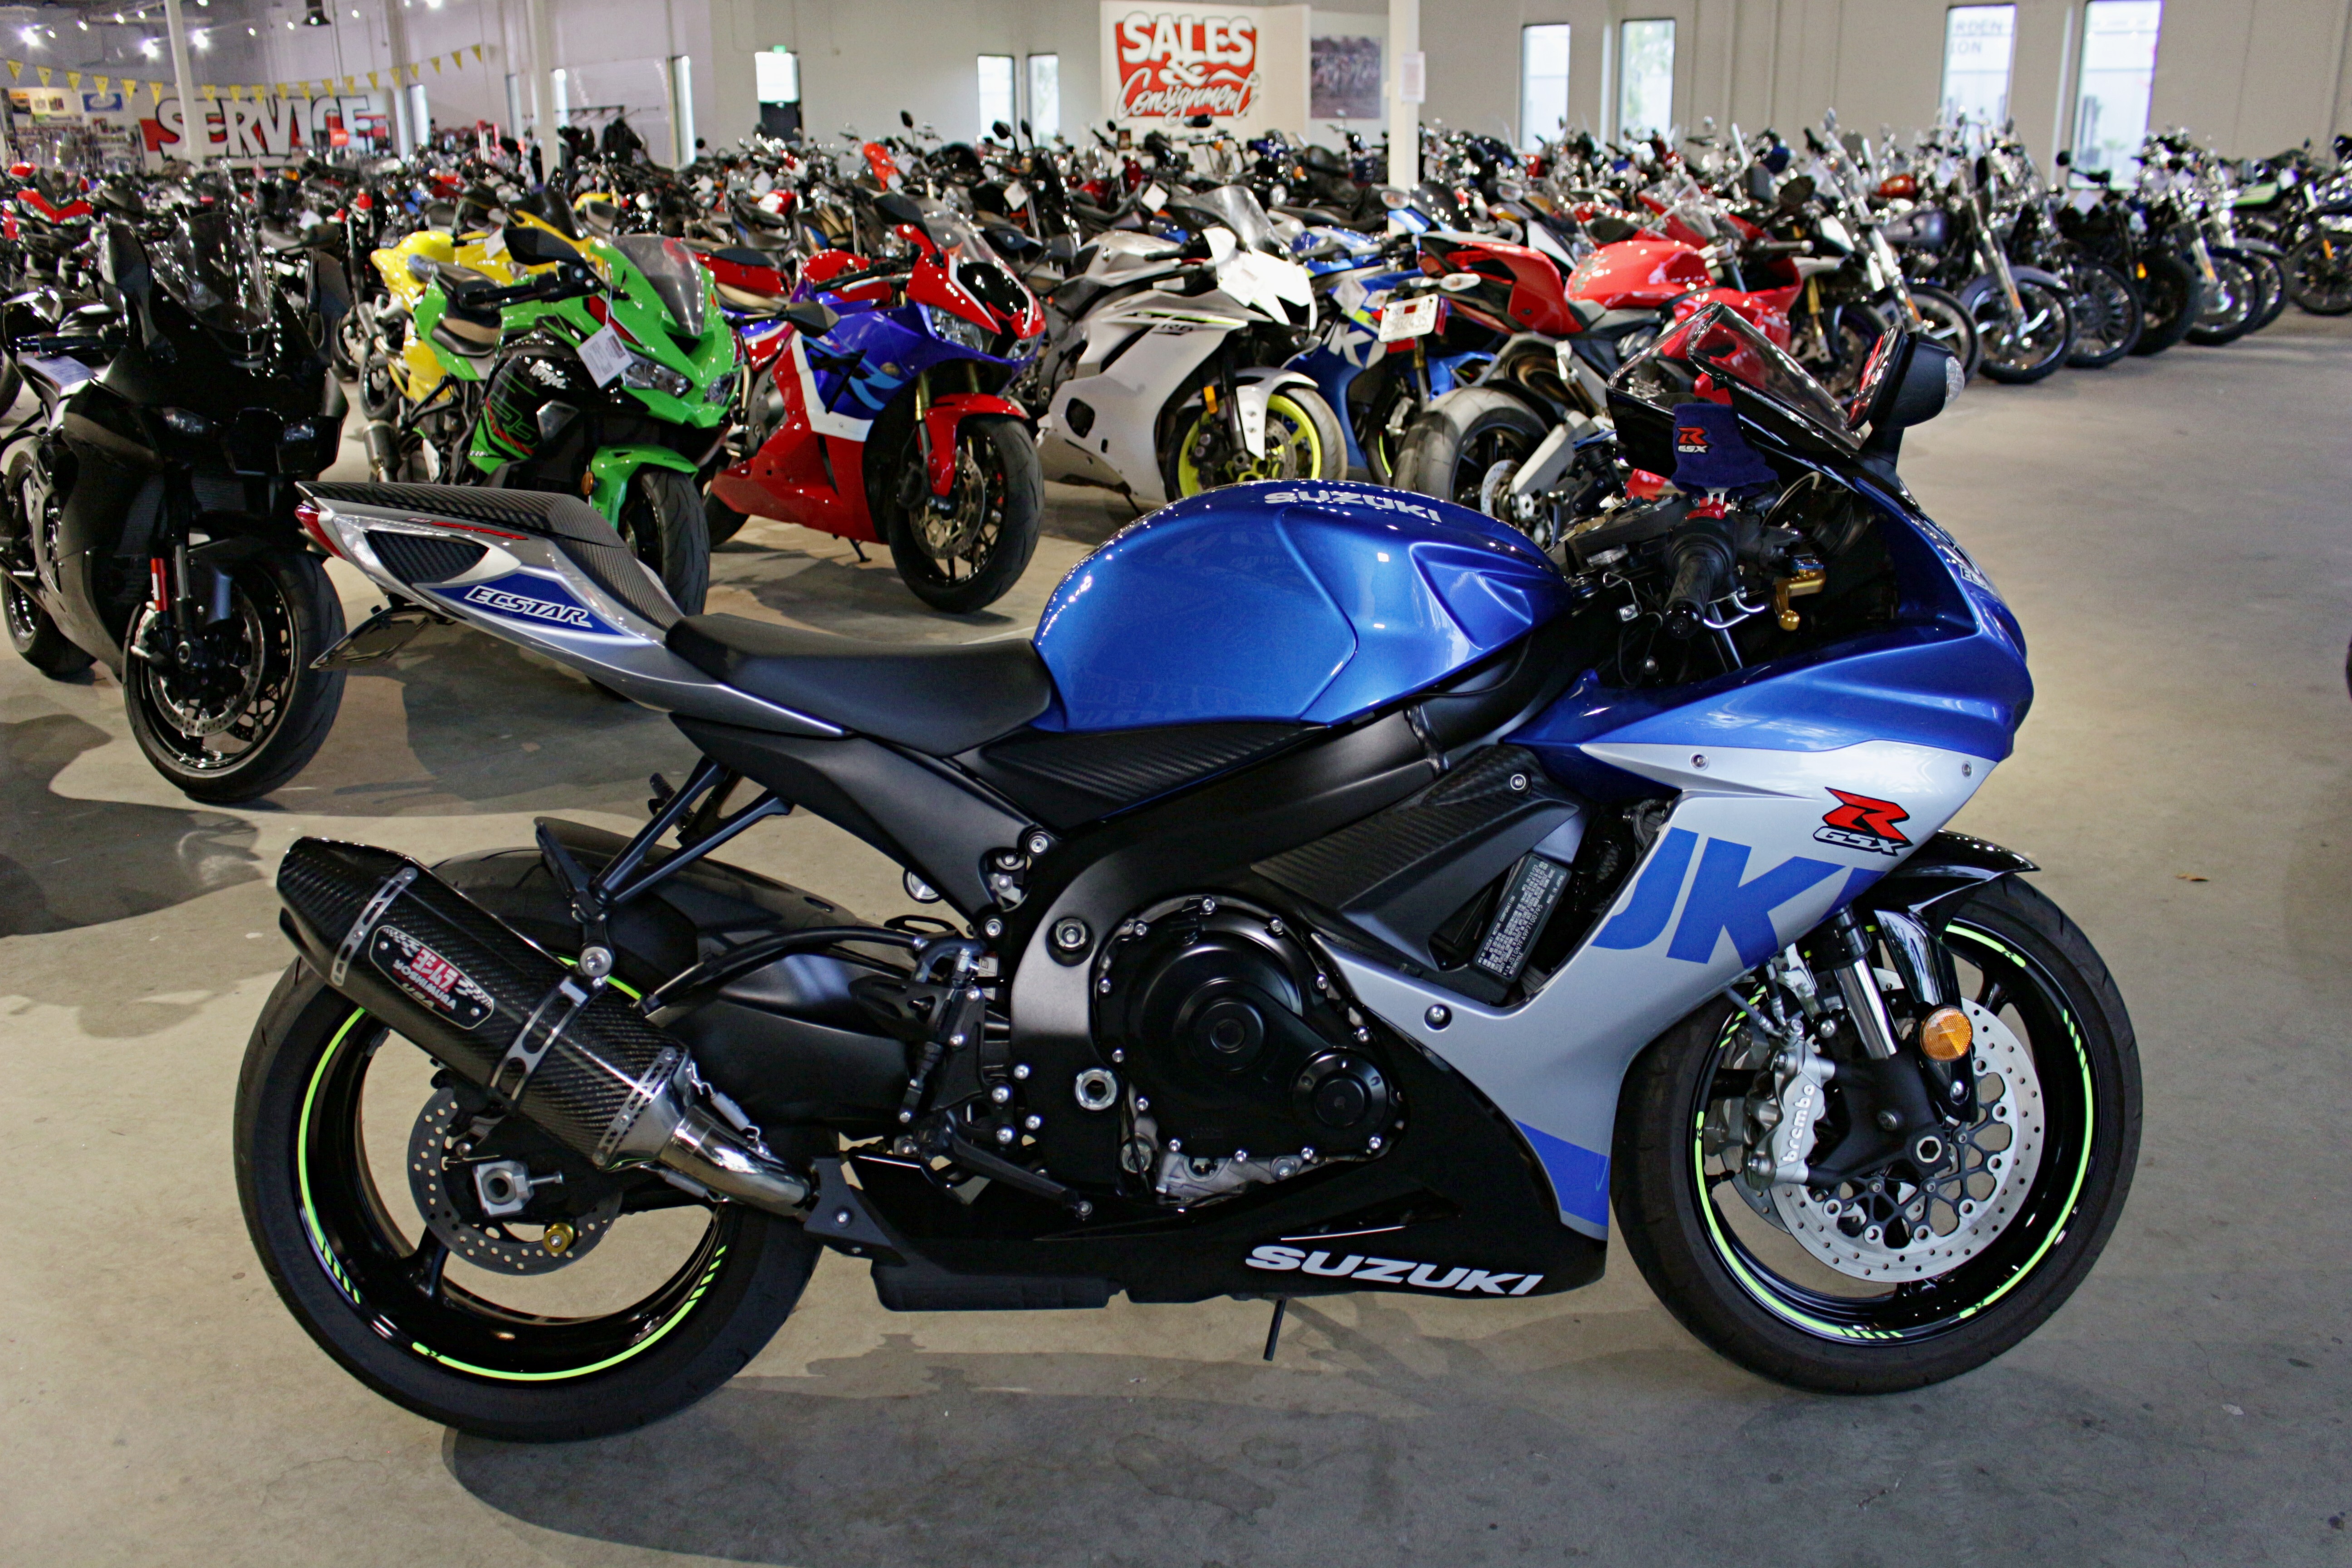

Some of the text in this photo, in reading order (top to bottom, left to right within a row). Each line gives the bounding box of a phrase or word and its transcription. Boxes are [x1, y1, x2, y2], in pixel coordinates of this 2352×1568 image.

[1121, 11, 1254, 67] SALES
[1115, 67, 1260, 126] Consignment
[1158, 58, 1206, 87] &
[1264, 491, 1442, 523] SUZUKI
[464, 585, 593, 627] ECSTAR
[1813, 826, 1907, 856] GSX
[393, 959, 456, 1010] YOSHIMURA
[1782, 1084, 1814, 1162] brembo
[1245, 1245, 1544, 1295] SUZUKI
